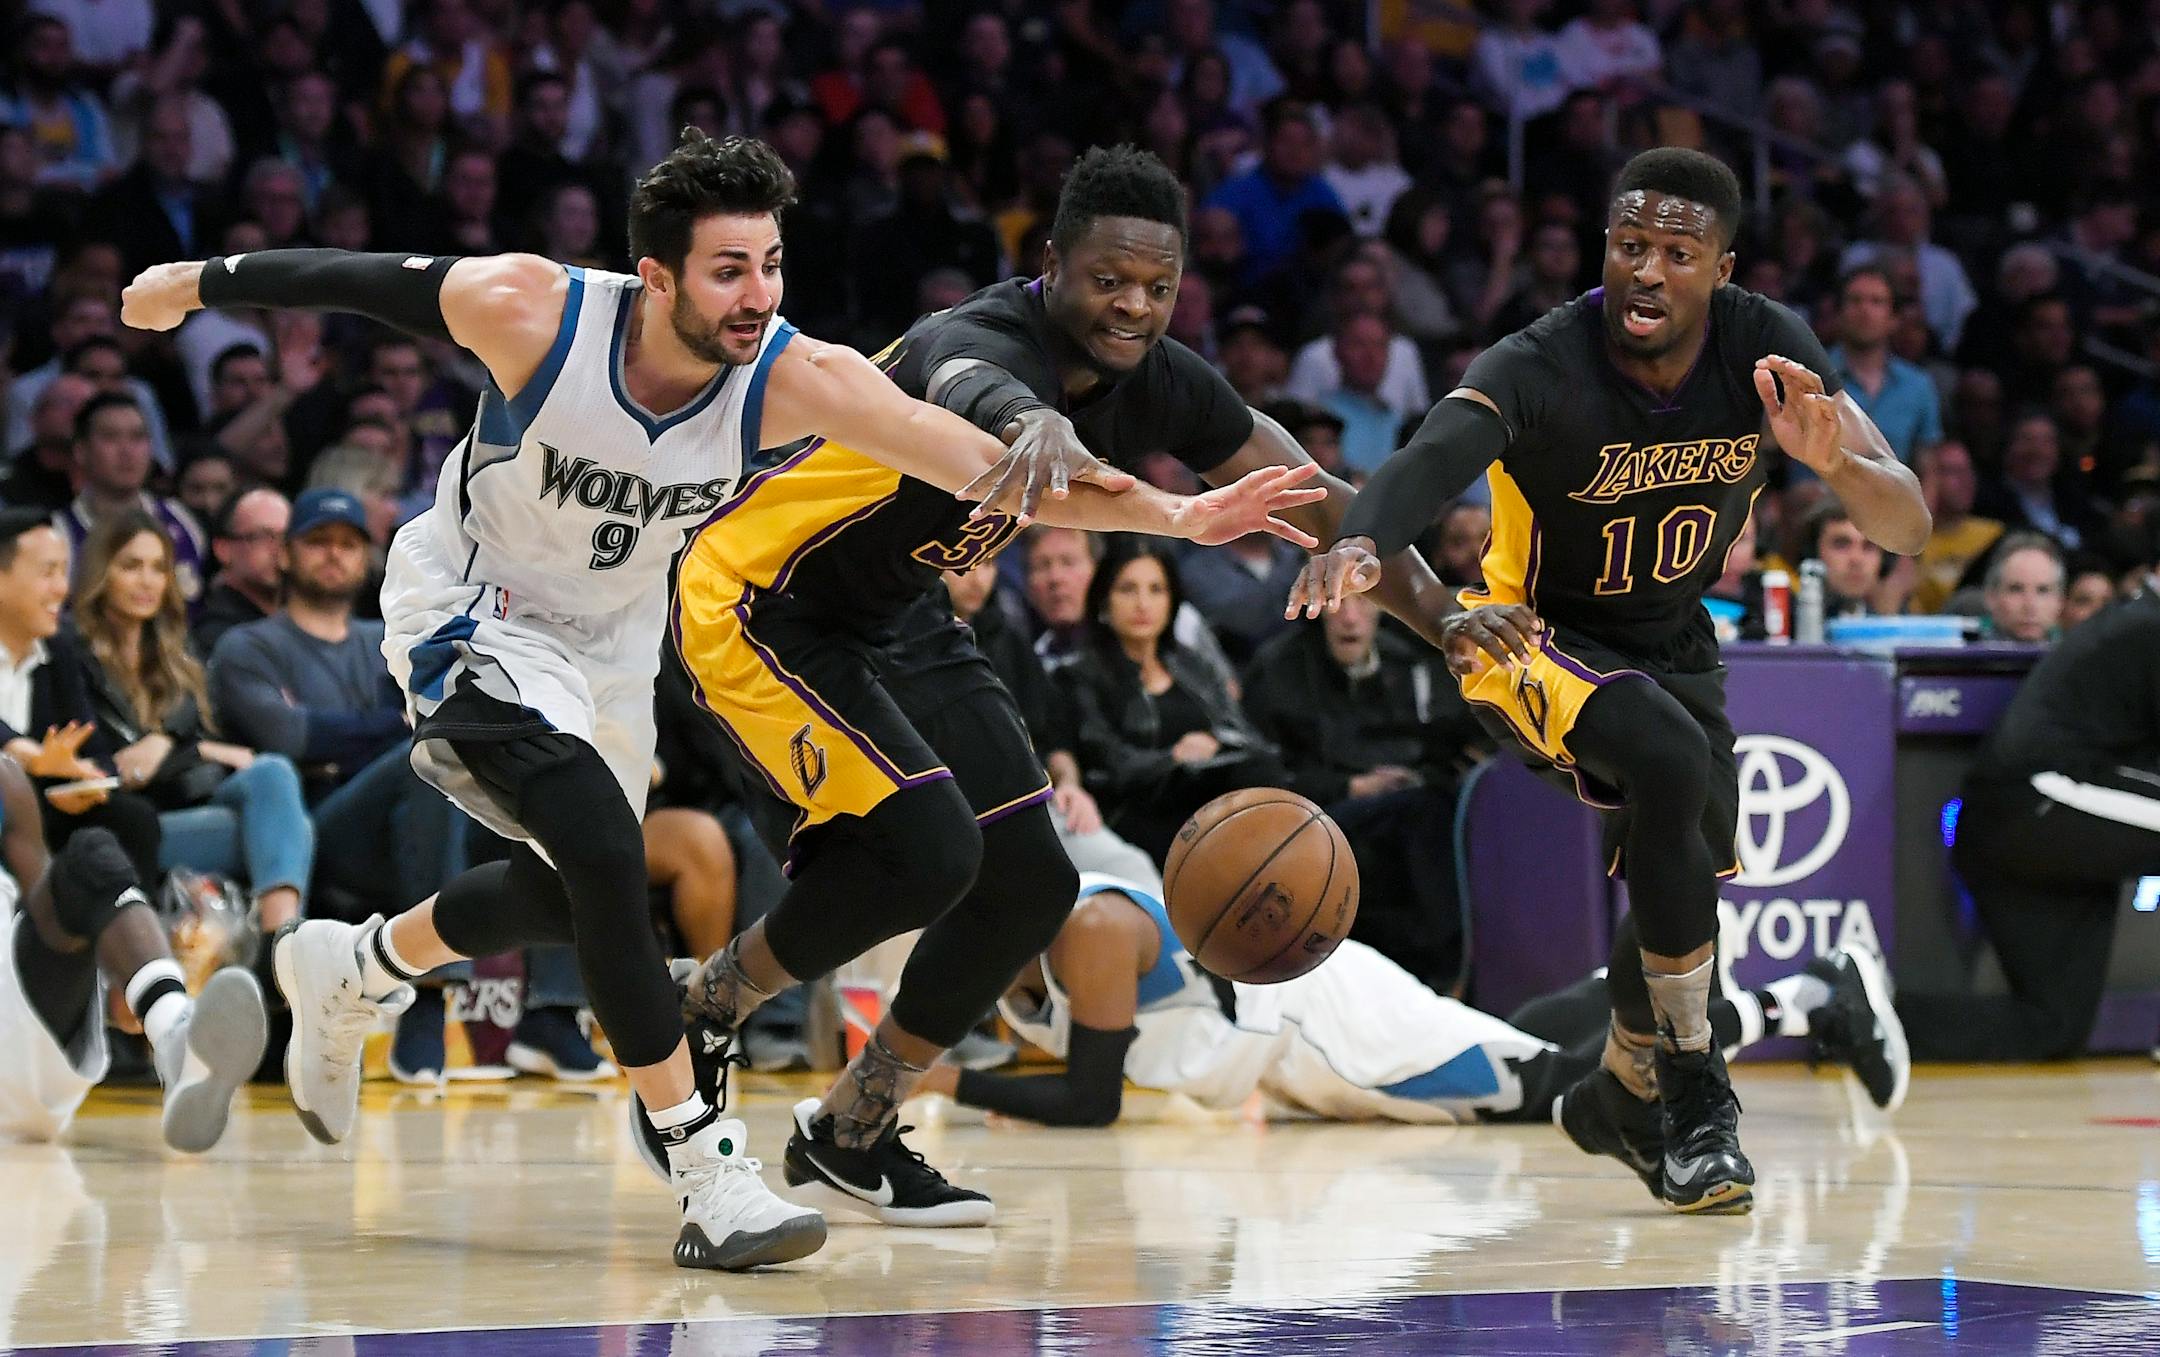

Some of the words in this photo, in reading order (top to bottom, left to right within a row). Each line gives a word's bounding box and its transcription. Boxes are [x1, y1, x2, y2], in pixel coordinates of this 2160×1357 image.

[538, 441, 732, 528] WOLVES
[1567, 434, 1760, 504] LAKERS
[589, 520, 640, 571] 9
[910, 509, 1022, 571] 3
[1594, 504, 1718, 596] 10
[1717, 897, 1886, 961] YOTA
